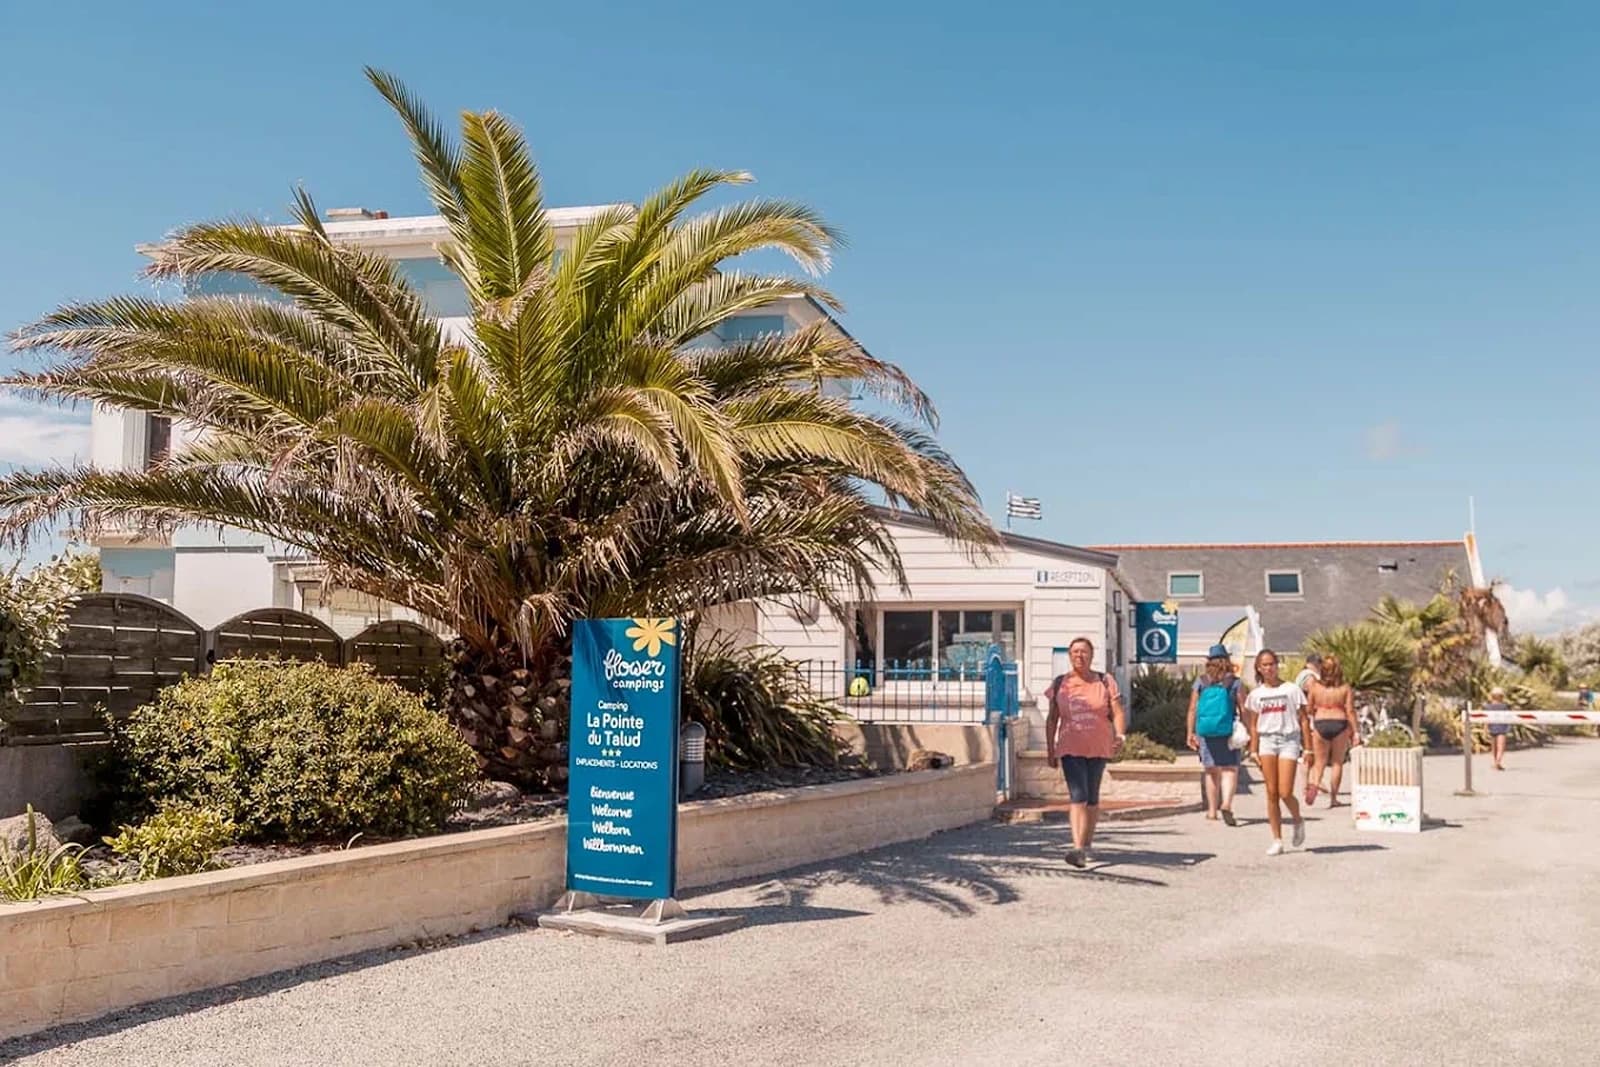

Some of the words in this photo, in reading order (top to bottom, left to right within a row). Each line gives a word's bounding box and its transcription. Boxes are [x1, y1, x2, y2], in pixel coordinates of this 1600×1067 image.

[603, 648, 666, 680] flower
[612, 676, 665, 693] campings
[597, 700, 629, 713] Camping
[586, 711, 600, 728] La
[602, 713, 644, 730] Pointe
[587, 729, 602, 746] du
[604, 730, 641, 748] Talud
[620, 760, 659, 770] LOCATIONS
[591, 803, 633, 819] Welcome
[582, 836, 645, 856] Willkommen
